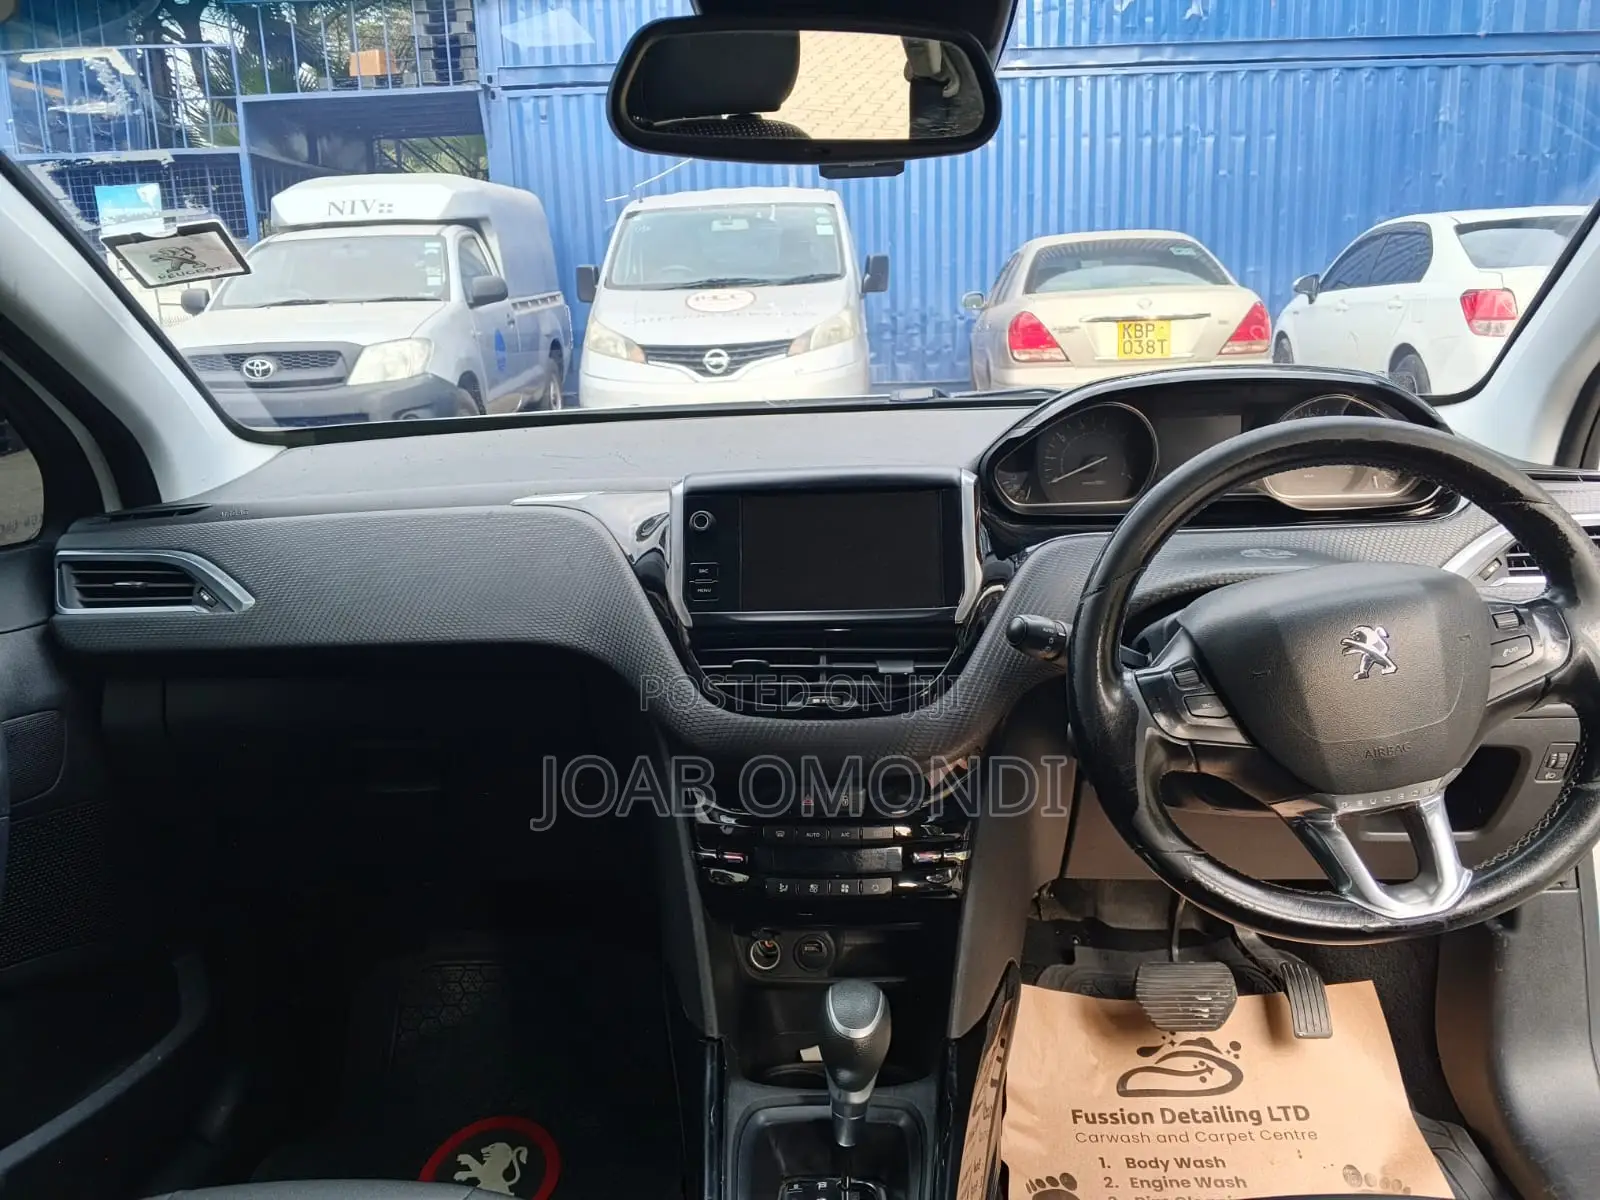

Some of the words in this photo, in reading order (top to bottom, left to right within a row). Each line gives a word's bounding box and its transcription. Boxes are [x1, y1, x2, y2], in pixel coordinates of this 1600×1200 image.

[1122, 323, 1156, 339] KBP
[1122, 339, 1168, 355] 038T
[1365, 742, 1412, 759] AIRBAG
[1071, 1108, 1155, 1125] Fussion
[1160, 1105, 1263, 1126] Detailing
[1267, 1105, 1311, 1122] LTD
[1075, 1131, 1151, 1144] Carwash
[1156, 1130, 1190, 1143] and
[1195, 1130, 1255, 1145] Carpet
[1259, 1129, 1319, 1141] Centre
[1098, 1157, 1111, 1169] 1.
[1125, 1157, 1170, 1172] Body
[1175, 1156, 1227, 1169] Wash
[1103, 1176, 1120, 1189] 2.
[1130, 1176, 1192, 1192] Engine
[1194, 1175, 1248, 1188] Wash
